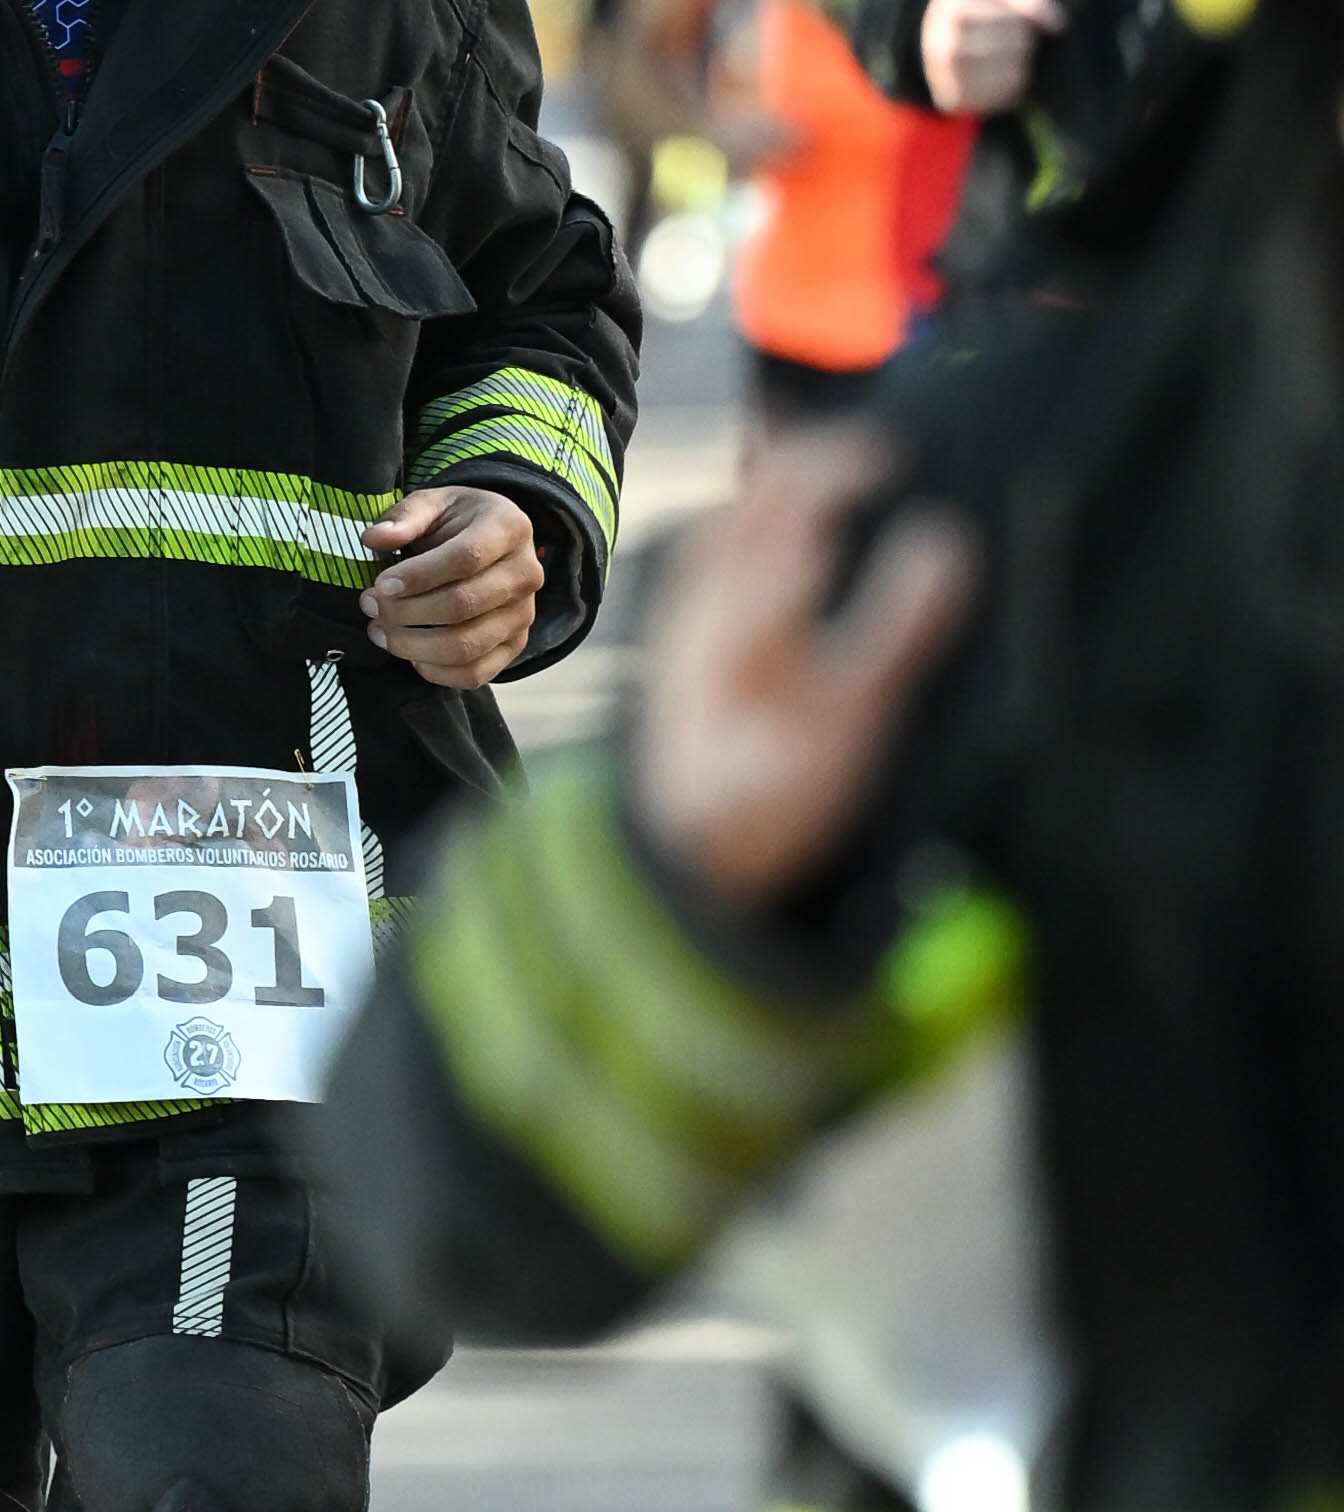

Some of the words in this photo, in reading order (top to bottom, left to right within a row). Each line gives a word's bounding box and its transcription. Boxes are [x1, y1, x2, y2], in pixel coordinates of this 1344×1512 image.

[109, 787, 312, 840] MARATÓN
[26, 844, 112, 866] ASOCIACIÓN
[115, 847, 194, 864] BOMBEROS
[196, 847, 286, 868] VOLUNTARIOS
[290, 851, 348, 870] ROSARIO
[57, 889, 325, 1008] 631
[189, 1039, 219, 1067] 27
